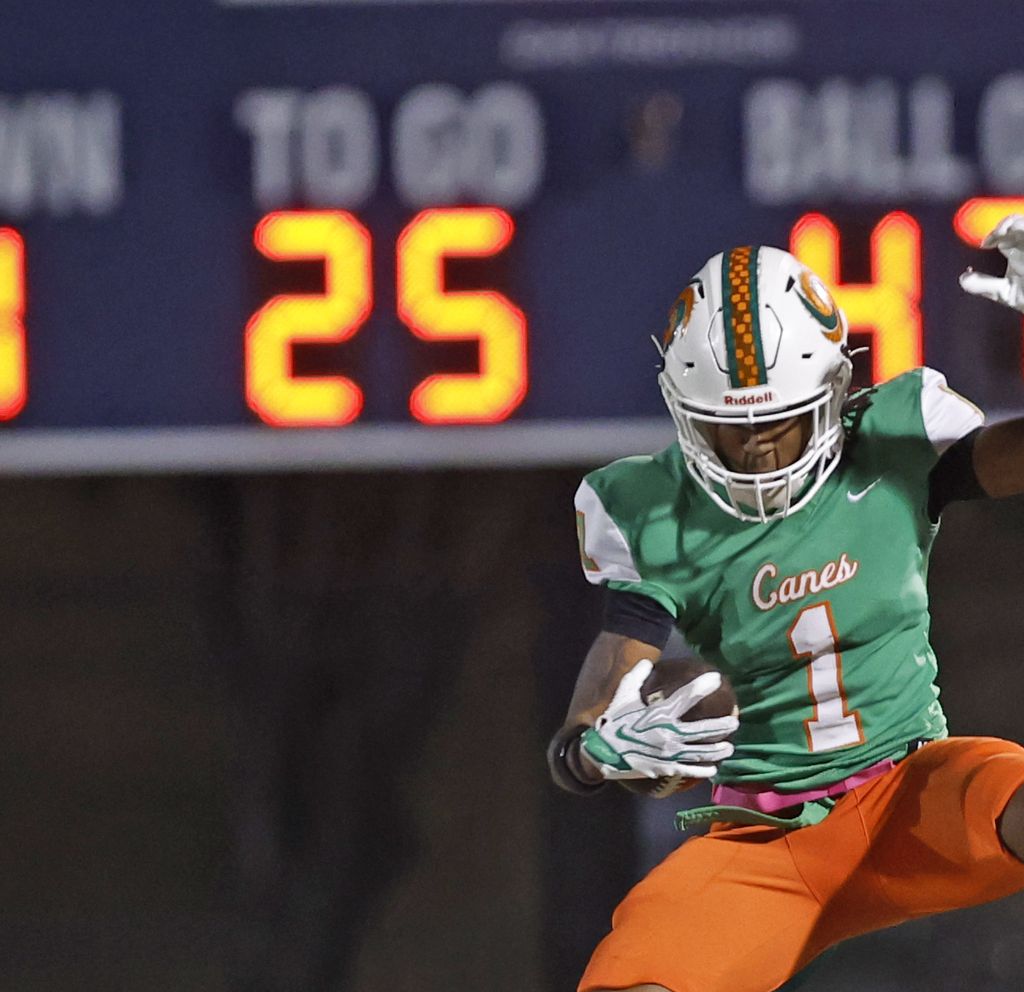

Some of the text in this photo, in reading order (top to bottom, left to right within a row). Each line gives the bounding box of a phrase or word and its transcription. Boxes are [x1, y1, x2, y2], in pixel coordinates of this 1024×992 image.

[235, 84, 544, 208] TO GO
[745, 80, 972, 201] BALL
[245, 208, 527, 427] 25
[724, 392, 772, 406] Riddell
[752, 553, 859, 611] Canes
[786, 600, 867, 753] 1
